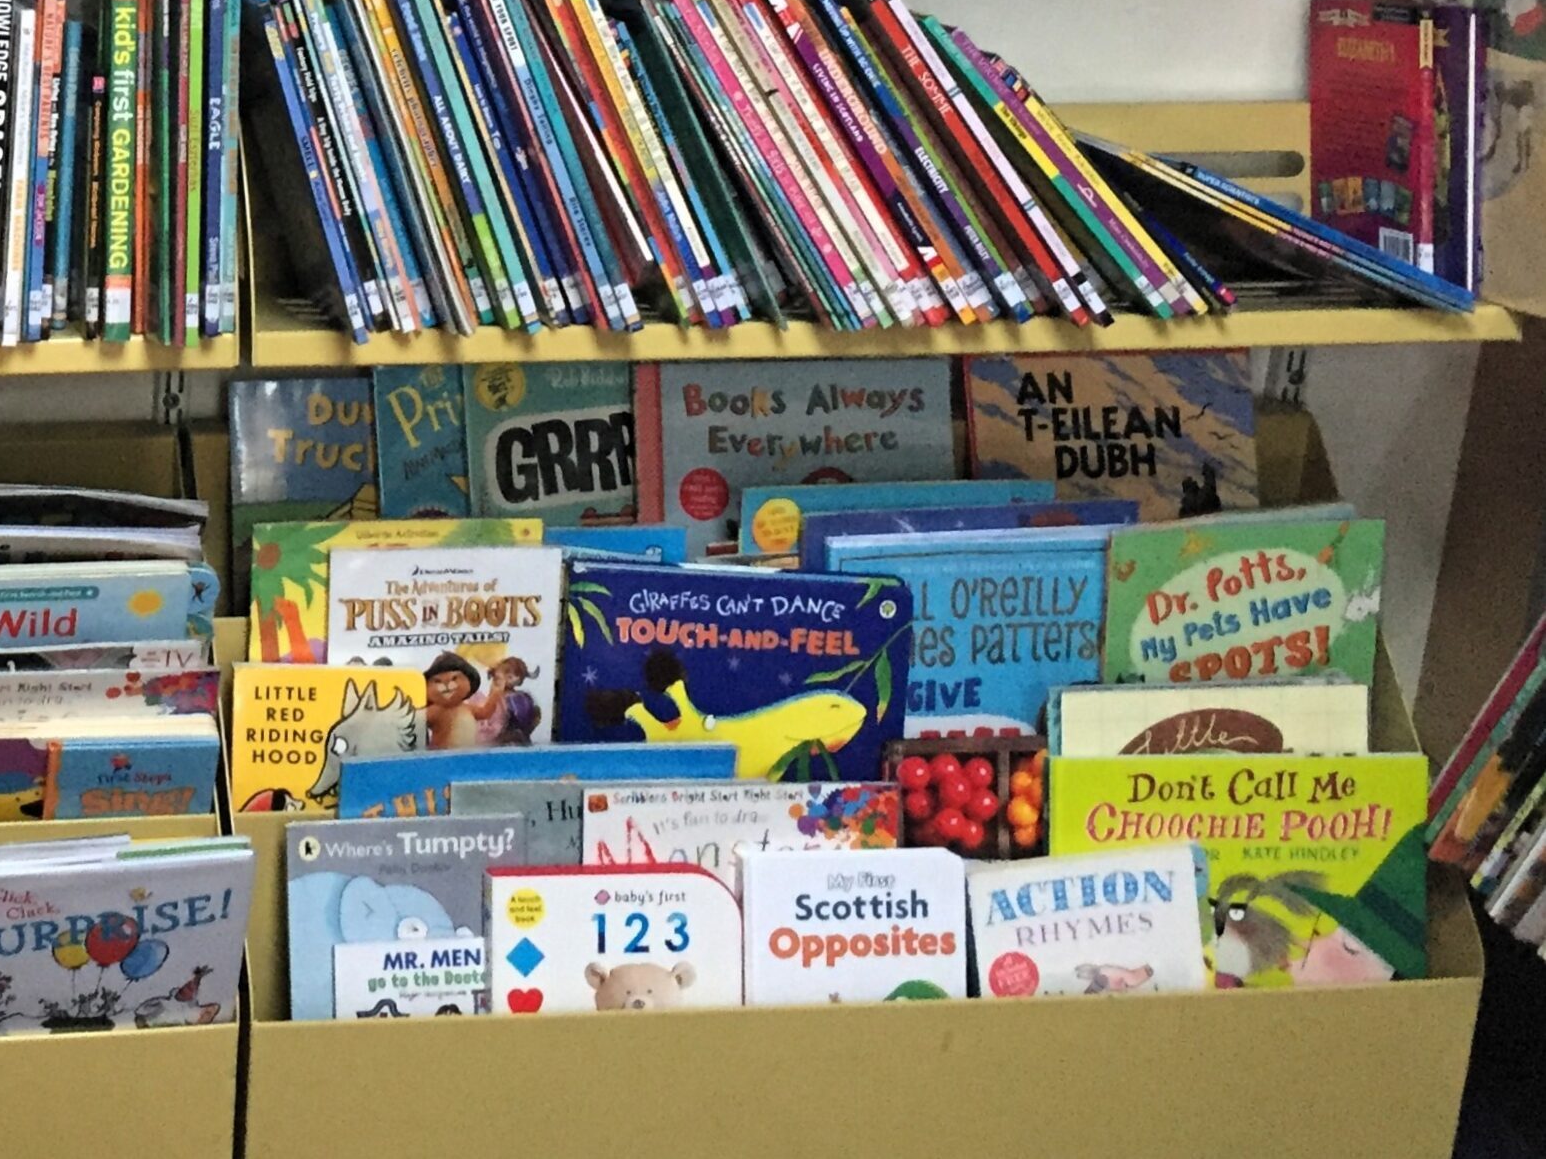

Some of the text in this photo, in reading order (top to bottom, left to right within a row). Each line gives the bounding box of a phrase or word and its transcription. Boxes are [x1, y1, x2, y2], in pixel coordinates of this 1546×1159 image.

[902, 45, 954, 116] THE SOMME
[108, 6, 137, 270] kid's first GARDENING
[208, 97, 223, 150] EAGLE
[433, 95, 471, 184] ALL ABOUT DAIRY
[914, 146, 950, 194] ELECTRICITY
[683, 383, 926, 419] Books Always
[1017, 371, 1073, 405] AN
[1016, 406, 1183, 442] T-EILEAN
[707, 426, 898, 470] Everywhere
[1054, 444, 1156, 478] DUBH
[386, 578, 498, 595] The Adventures of
[1146, 551, 1306, 625] Dr. Potts,
[339, 595, 542, 631] PUSS BOOTS
[629, 589, 846, 623] GIRAFFES CAN'T DANCE
[368, 632, 510, 648] AMAZING TAILS!
[616, 617, 860, 655] TOUCH-AND-FEEL
[1140, 587, 1332, 663] My Pets Have
[1168, 625, 1331, 682] SPOTS!
[254, 686, 317, 701] LITTLE
[266, 708, 304, 722] RED
[246, 728, 324, 743] RIDING
[252, 749, 317, 764] HOOD
[1128, 768, 1356, 805] Don't Call Me
[1085, 802, 1392, 842] CHOOCHIE POOH!
[325, 828, 515, 859] Where's Tumpty?
[614, 891, 687, 904] baby's first
[827, 871, 896, 891] My First
[986, 869, 1175, 927] ACTION
[794, 889, 930, 922] Scottish
[768, 924, 956, 968] Opposites
[1015, 912, 1154, 949] RHYMES
[383, 948, 482, 971] MR. MEN
[368, 971, 440, 992] go to the
